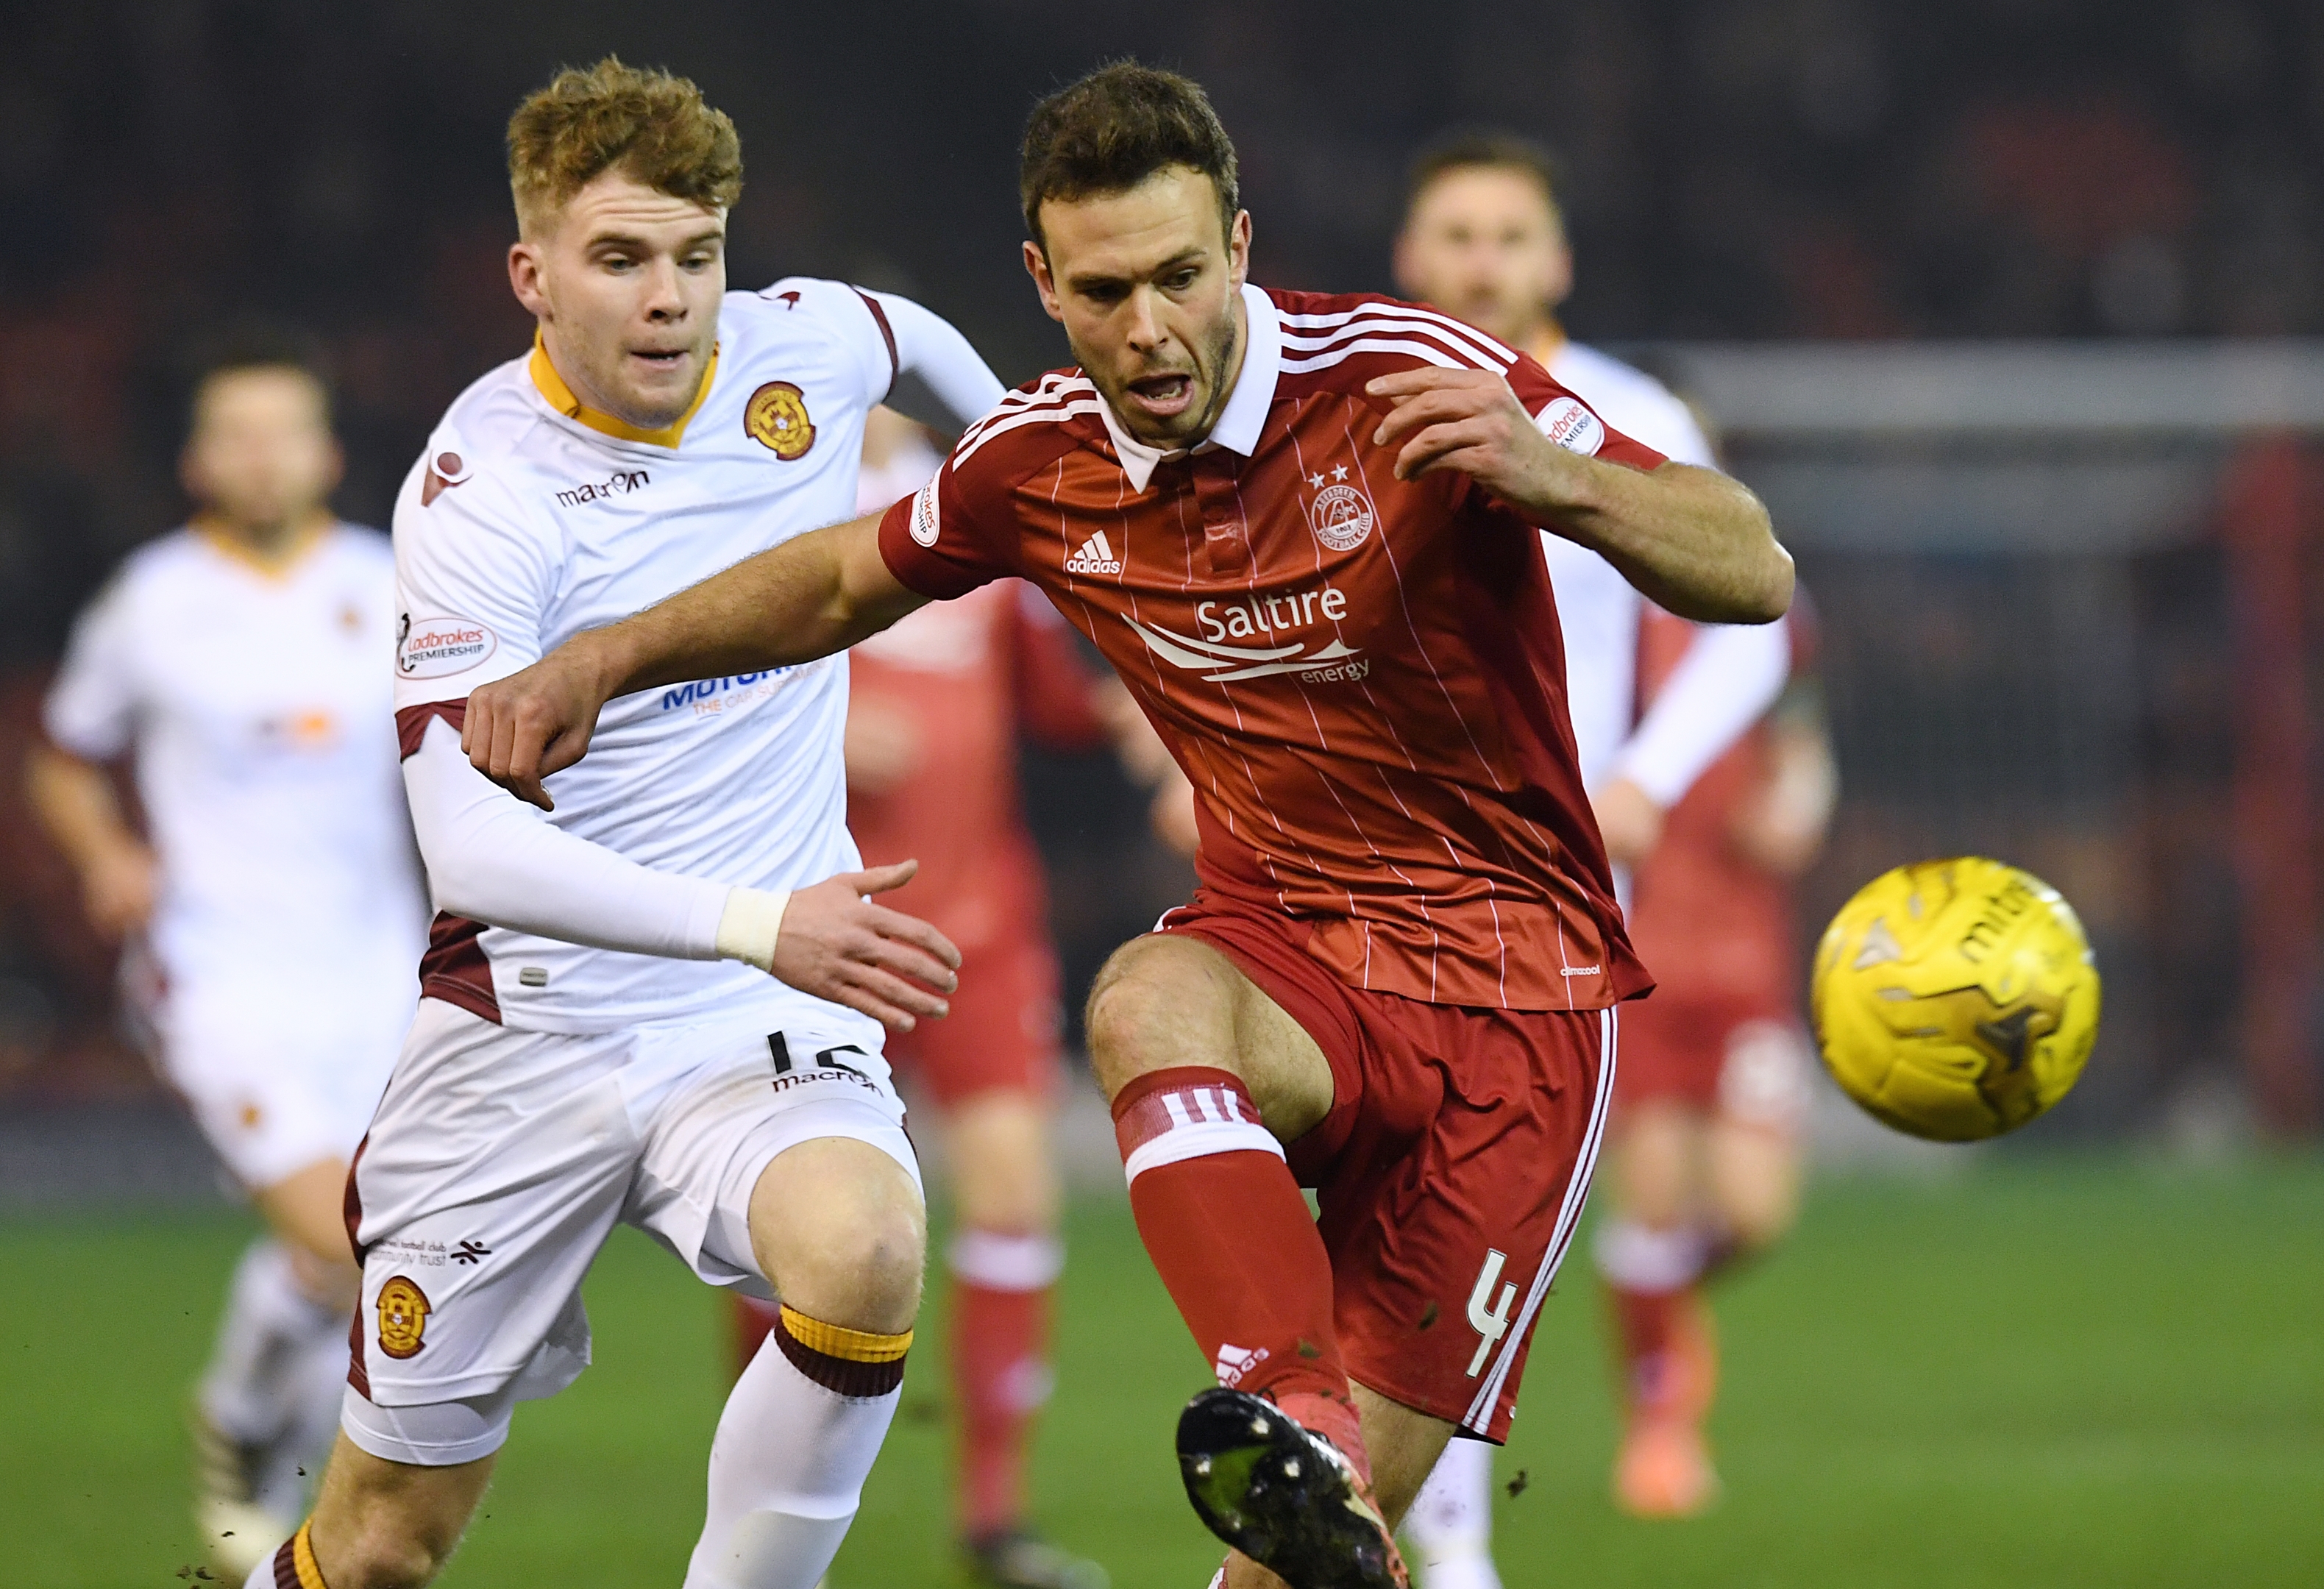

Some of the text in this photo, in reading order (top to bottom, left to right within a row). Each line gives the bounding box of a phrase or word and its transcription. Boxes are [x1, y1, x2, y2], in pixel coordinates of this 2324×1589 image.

[1316, 488, 1357, 511] ABERDEEN
[1357, 512, 1371, 537] CLUB
[1318, 527, 1360, 549] FOOTBALL
[1066, 558, 1120, 574] adidas
[1198, 588, 1347, 642] Saltire
[408, 629, 484, 653] Ladbrokes
[408, 644, 486, 664] PREMIERSHIP
[1301, 659, 1370, 684] energy
[693, 699, 722, 714] THE
[772, 1070, 884, 1098] macron
[428, 1240, 447, 1253] club
[419, 1252, 447, 1267] trust
[1465, 1248, 1518, 1379] 4
